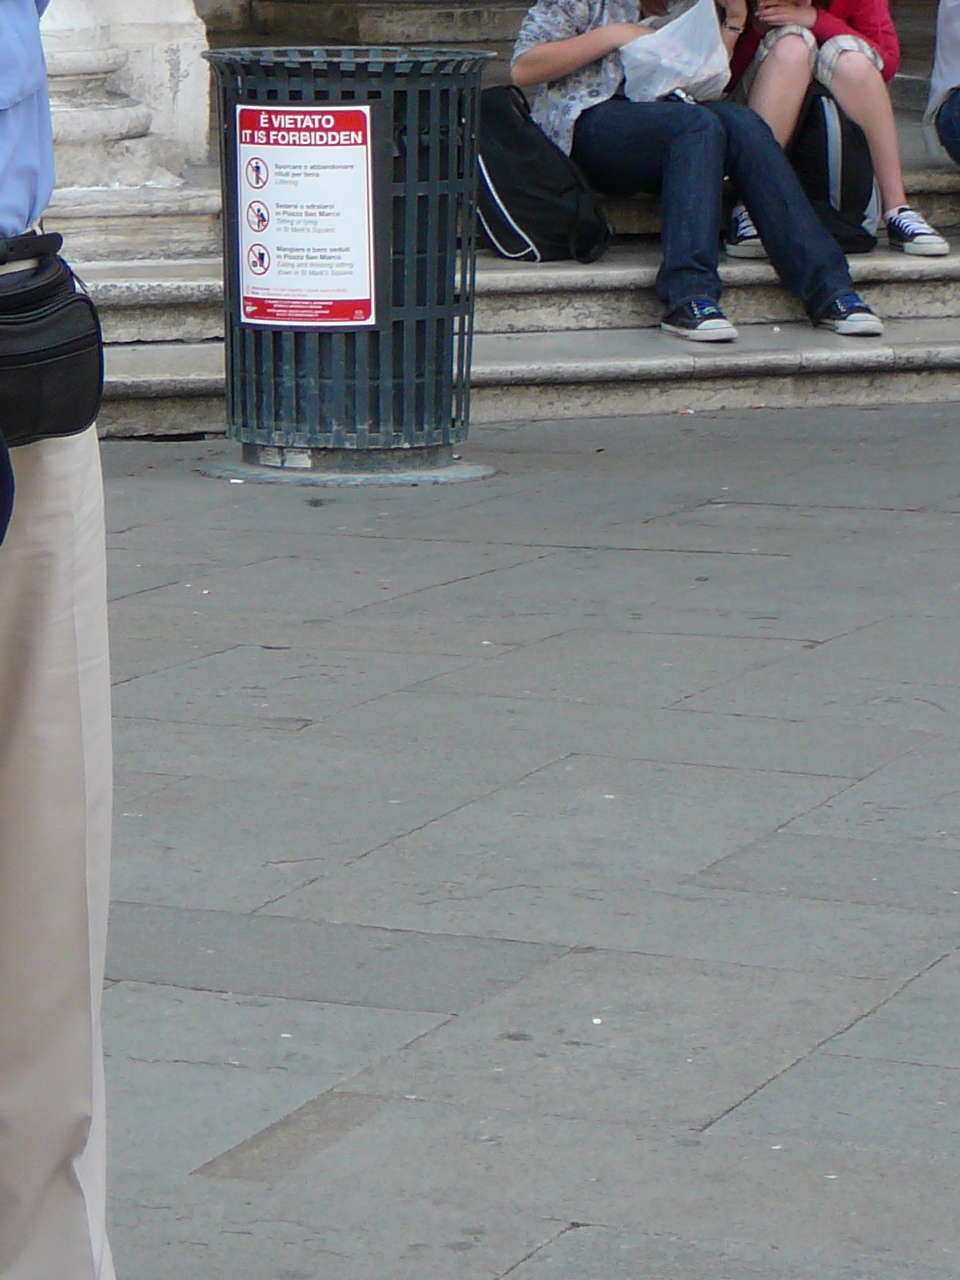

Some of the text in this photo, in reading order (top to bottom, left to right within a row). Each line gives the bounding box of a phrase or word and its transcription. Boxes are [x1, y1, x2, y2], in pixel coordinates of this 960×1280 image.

[260, 111, 335, 129] È VIETATO
[241, 130, 363, 145] IT IS FORBIDDEN
